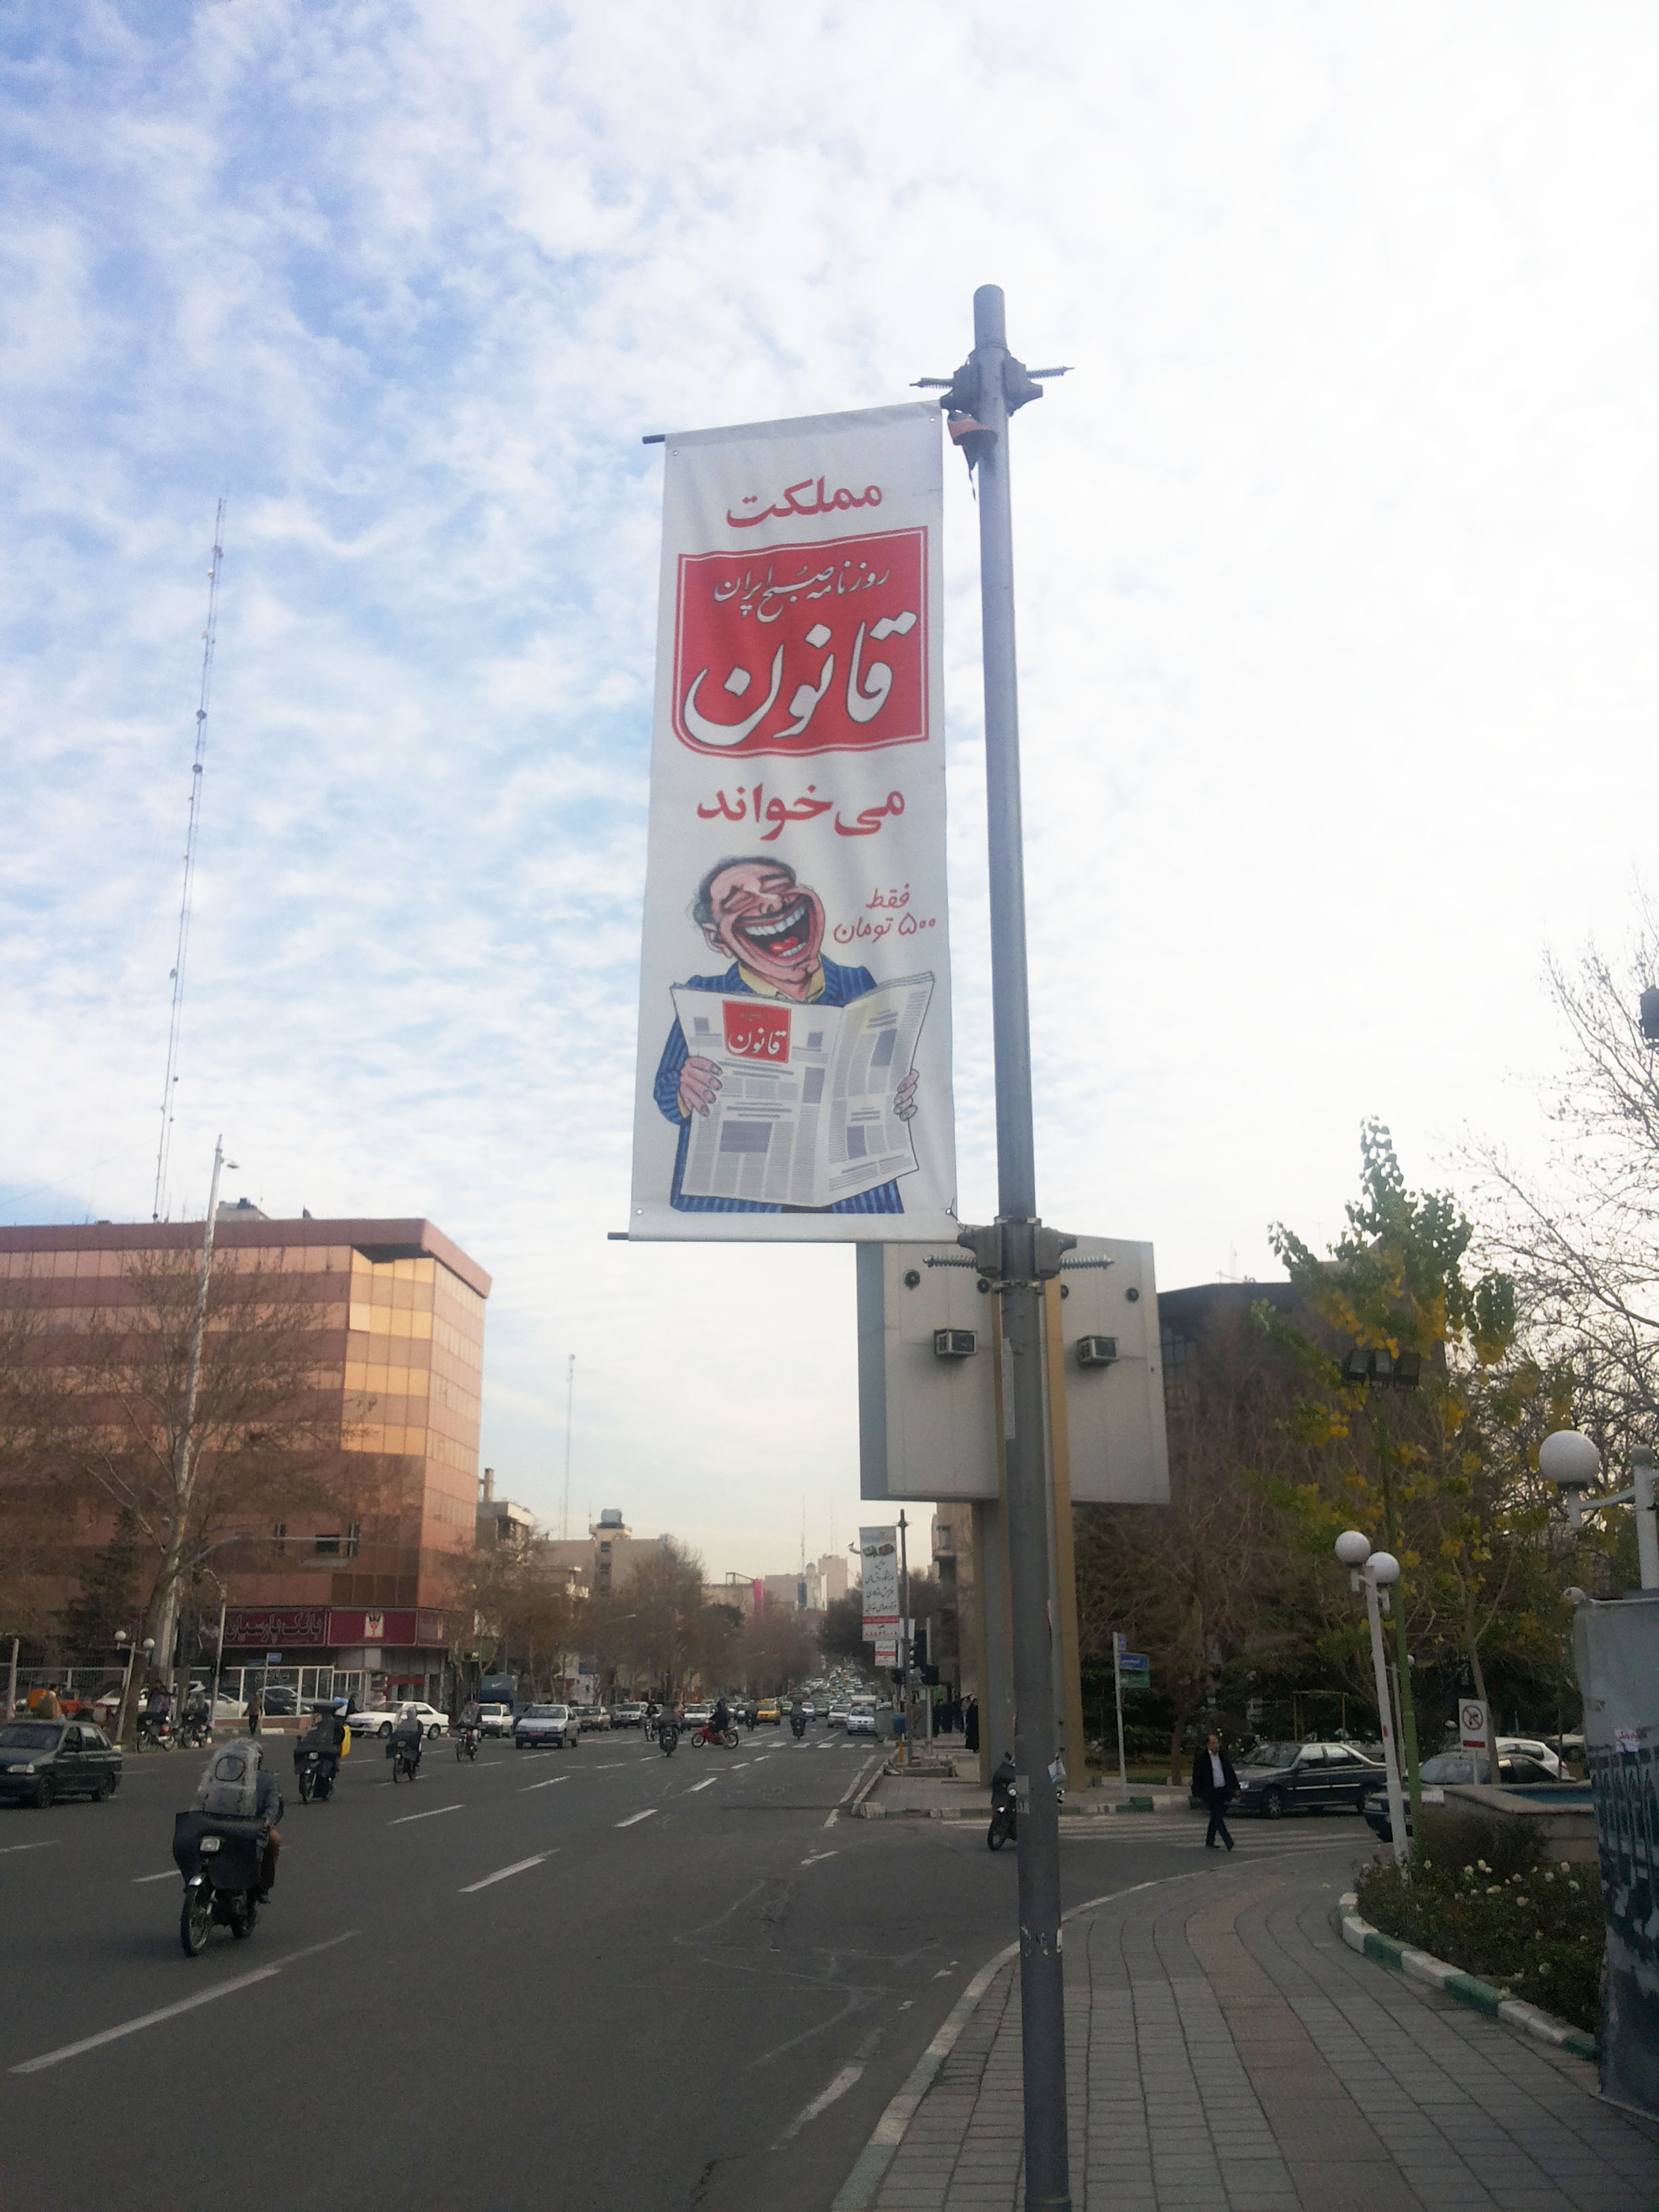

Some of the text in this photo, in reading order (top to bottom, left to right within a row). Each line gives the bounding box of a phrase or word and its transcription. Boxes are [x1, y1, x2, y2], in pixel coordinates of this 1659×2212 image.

[726, 476, 882, 529] مملکت
[714, 565, 773, 618] ایران
[683, 611, 918, 747] قانون
[865, 882, 910, 909] فقط
[834, 912, 936, 944] ۵۰۰ تومان
[727, 1027, 787, 1055] قانون
[224, 1612, 323, 1645] بانک پارسیان
